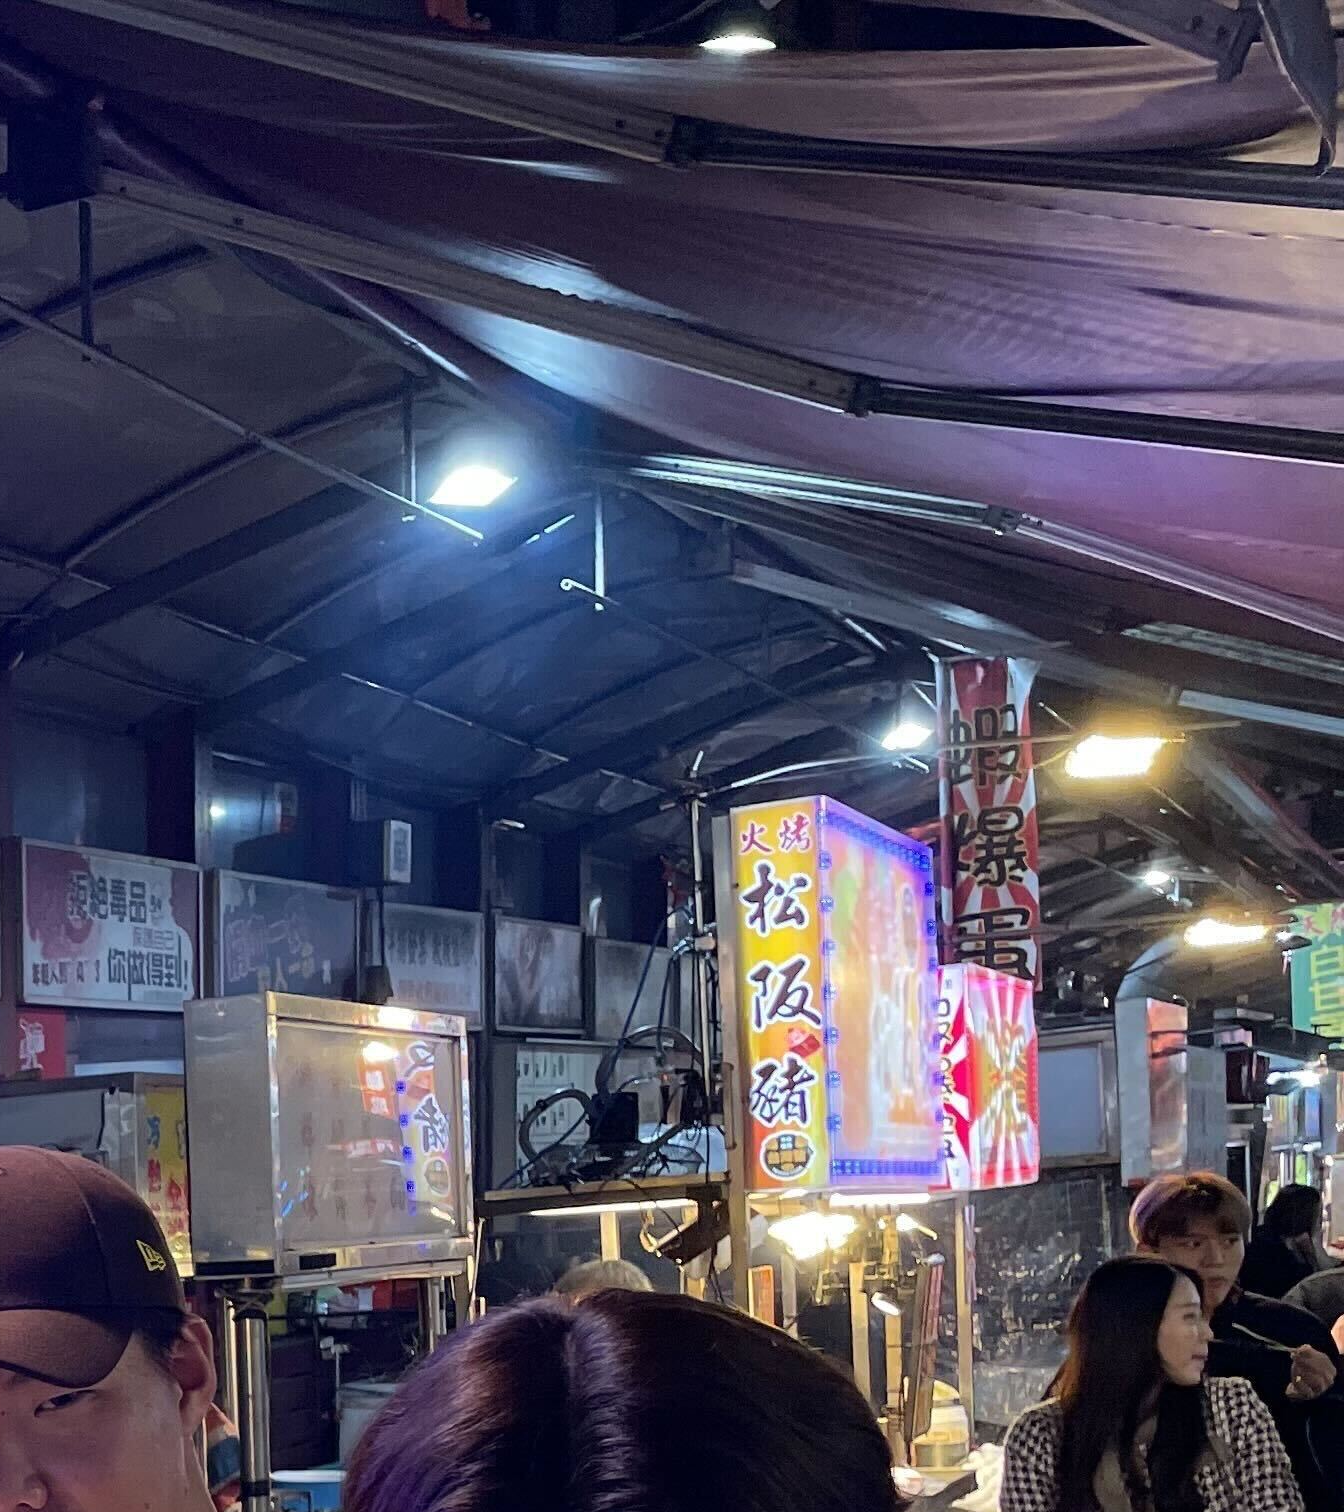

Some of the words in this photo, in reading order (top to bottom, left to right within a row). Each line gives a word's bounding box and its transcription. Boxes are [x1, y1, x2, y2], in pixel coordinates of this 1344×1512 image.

[739, 814, 810, 855] 火烤
[741, 862, 822, 1128] 松阪豬
